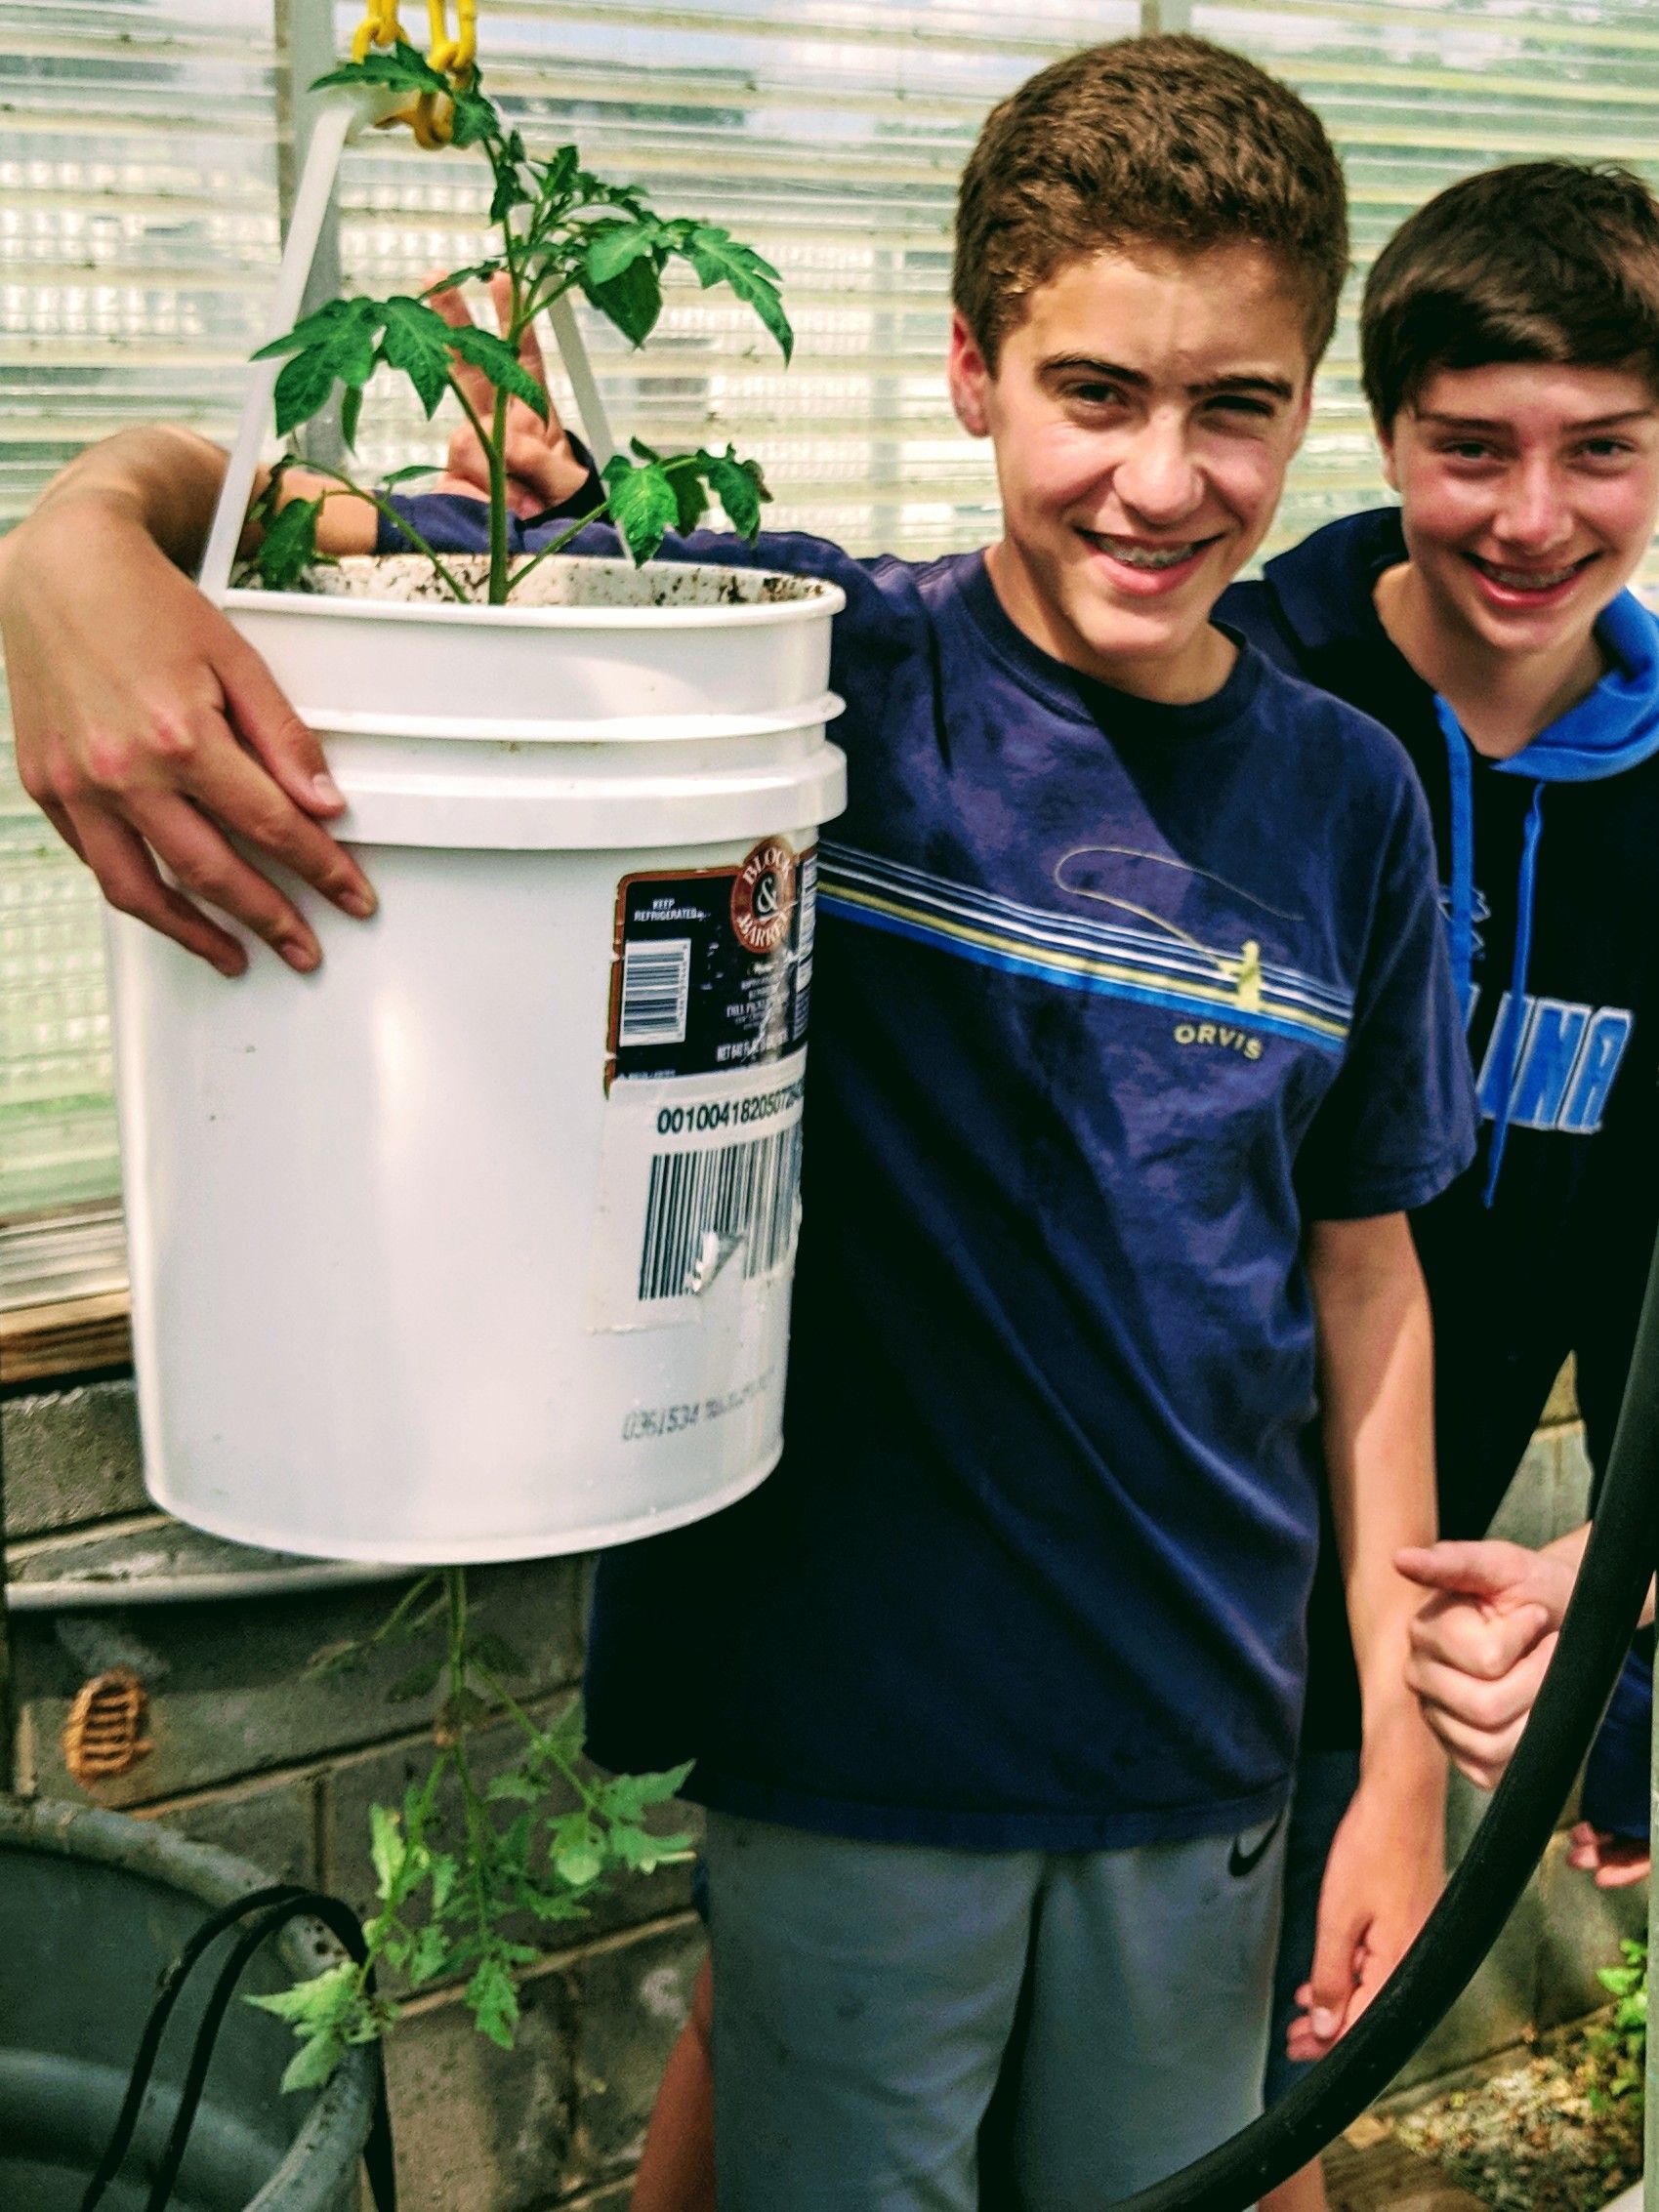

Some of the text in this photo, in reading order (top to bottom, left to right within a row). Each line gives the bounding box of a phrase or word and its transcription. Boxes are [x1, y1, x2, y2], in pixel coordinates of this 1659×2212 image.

[652, 898, 675, 910] KEEP
[757, 877, 778, 914] &
[634, 908, 697, 922] REFRIGERATED
[1174, 1024, 1263, 1059] ORVIS
[1465, 984, 1634, 1134] INA
